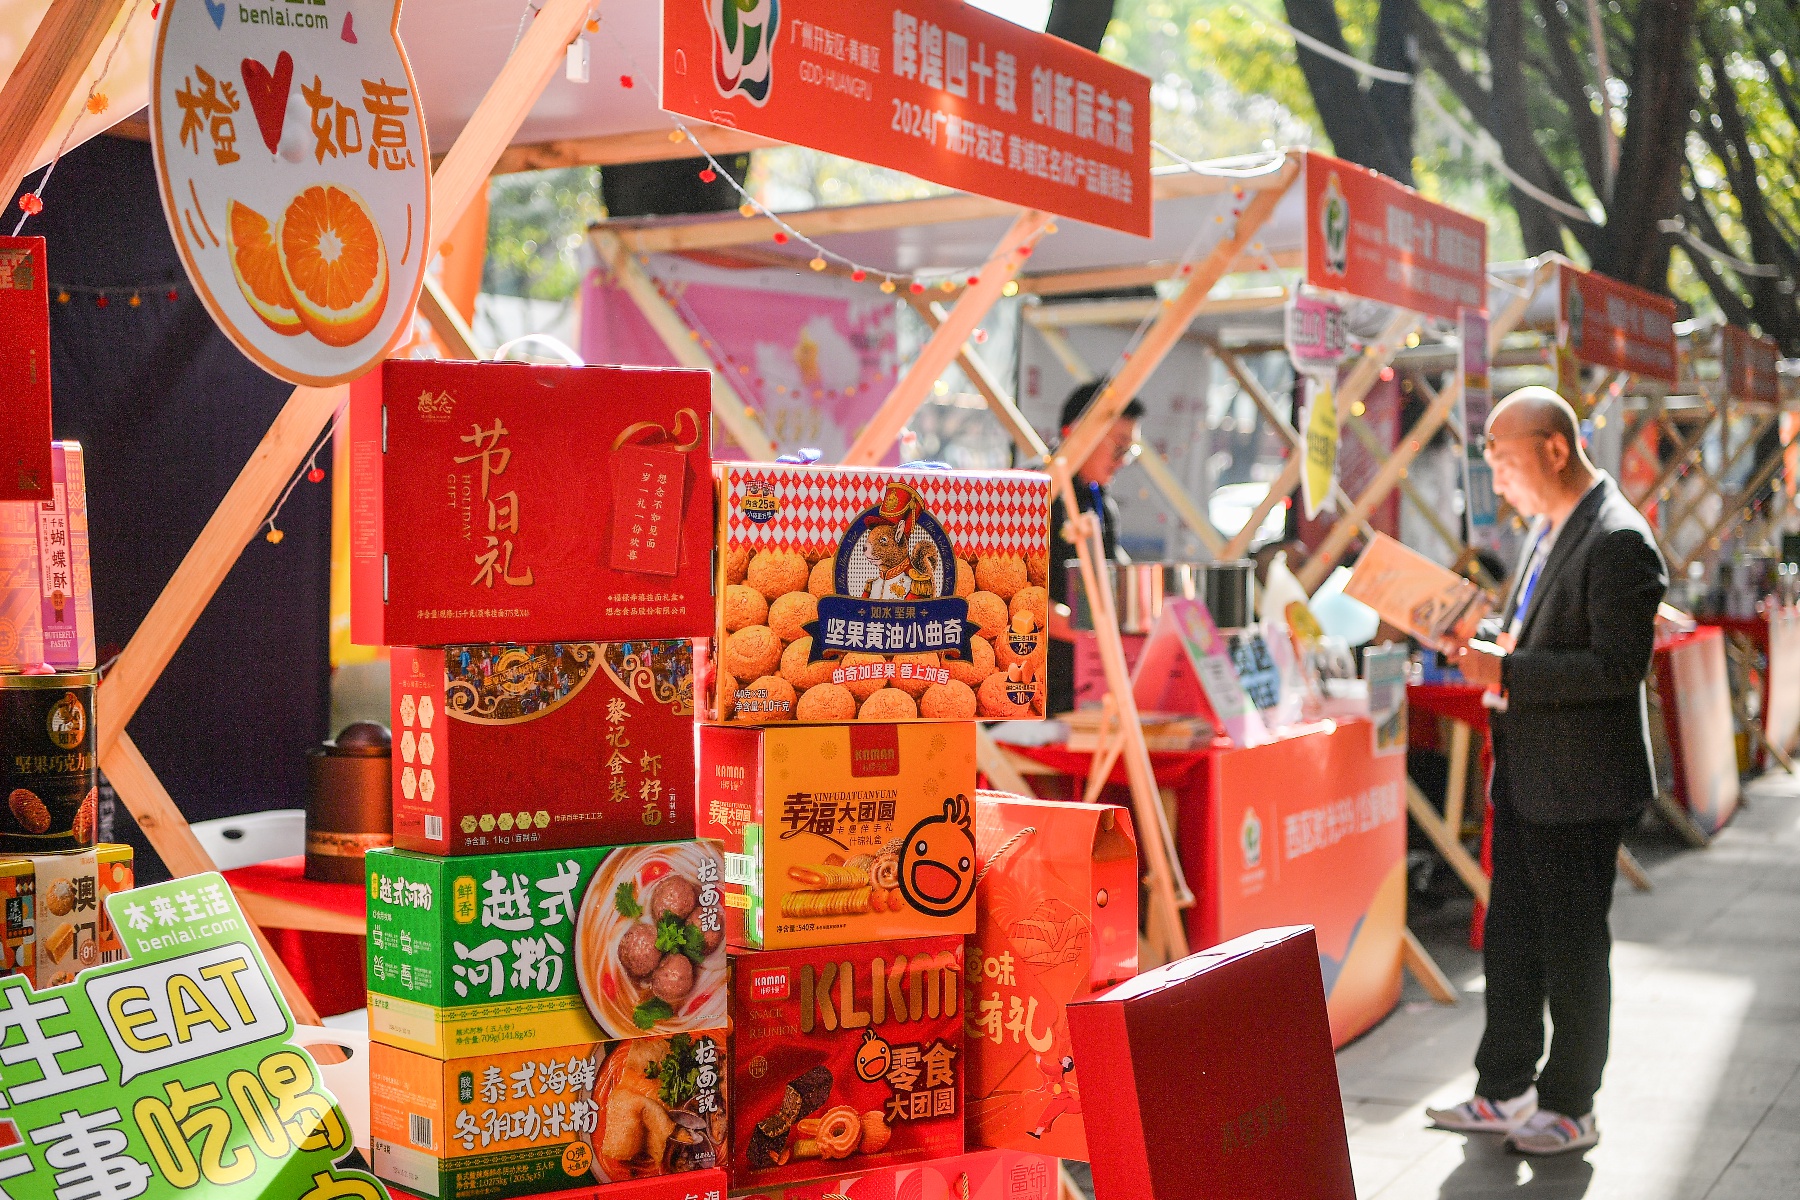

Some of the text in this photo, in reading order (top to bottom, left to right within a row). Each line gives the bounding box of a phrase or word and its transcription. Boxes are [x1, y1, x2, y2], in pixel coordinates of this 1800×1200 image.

[239, 4, 328, 29] benlai.com
[892, 9, 1018, 114] 辉煌四十载
[301, 75, 416, 171] 如意
[417, 389, 456, 414] 想念
[447, 474, 457, 508] GIFT
[453, 418, 534, 589] 节日礼
[461, 475, 471, 541] HOLIDAY
[745, 498, 775, 509] 内含25袋
[51, 528, 67, 589] 蝴蝶酥
[825, 617, 963, 650] 坚果黄油小曲奇
[832, 662, 950, 686] 曲奇加坚果 香上加香
[734, 700, 790, 711] 净含量:1.0千克
[605, 697, 632, 803] 黎记金装
[639, 750, 662, 826] 虾籽面
[715, 765, 745, 779] KAMAN
[709, 800, 751, 827] 幸福大团圆
[780, 792, 897, 838] 幸福大团圆
[123, 884, 233, 933] 本来生活
[380, 875, 432, 911] 越式河粉
[457, 883, 475, 917] 鲜香
[481, 859, 581, 932] 越式
[137, 918, 239, 953] benlai.com
[453, 932, 565, 997] 河粉
[755, 975, 786, 986] KAMAN
[107, 957, 257, 1053] EAT
[749, 1009, 782, 1020] SNACK
[749, 1025, 798, 1039] REUNION
[480, 1056, 597, 1104] 泰式海鲜
[887, 1044, 958, 1091] 零食
[460, 1077, 473, 1101] 酸辣
[887, 1086, 956, 1122] 大团圆
[133, 1051, 347, 1189] 吃喝
[453, 1098, 600, 1150] 冬阴功米粉
[1010, 1162, 1047, 1193] 富锦
